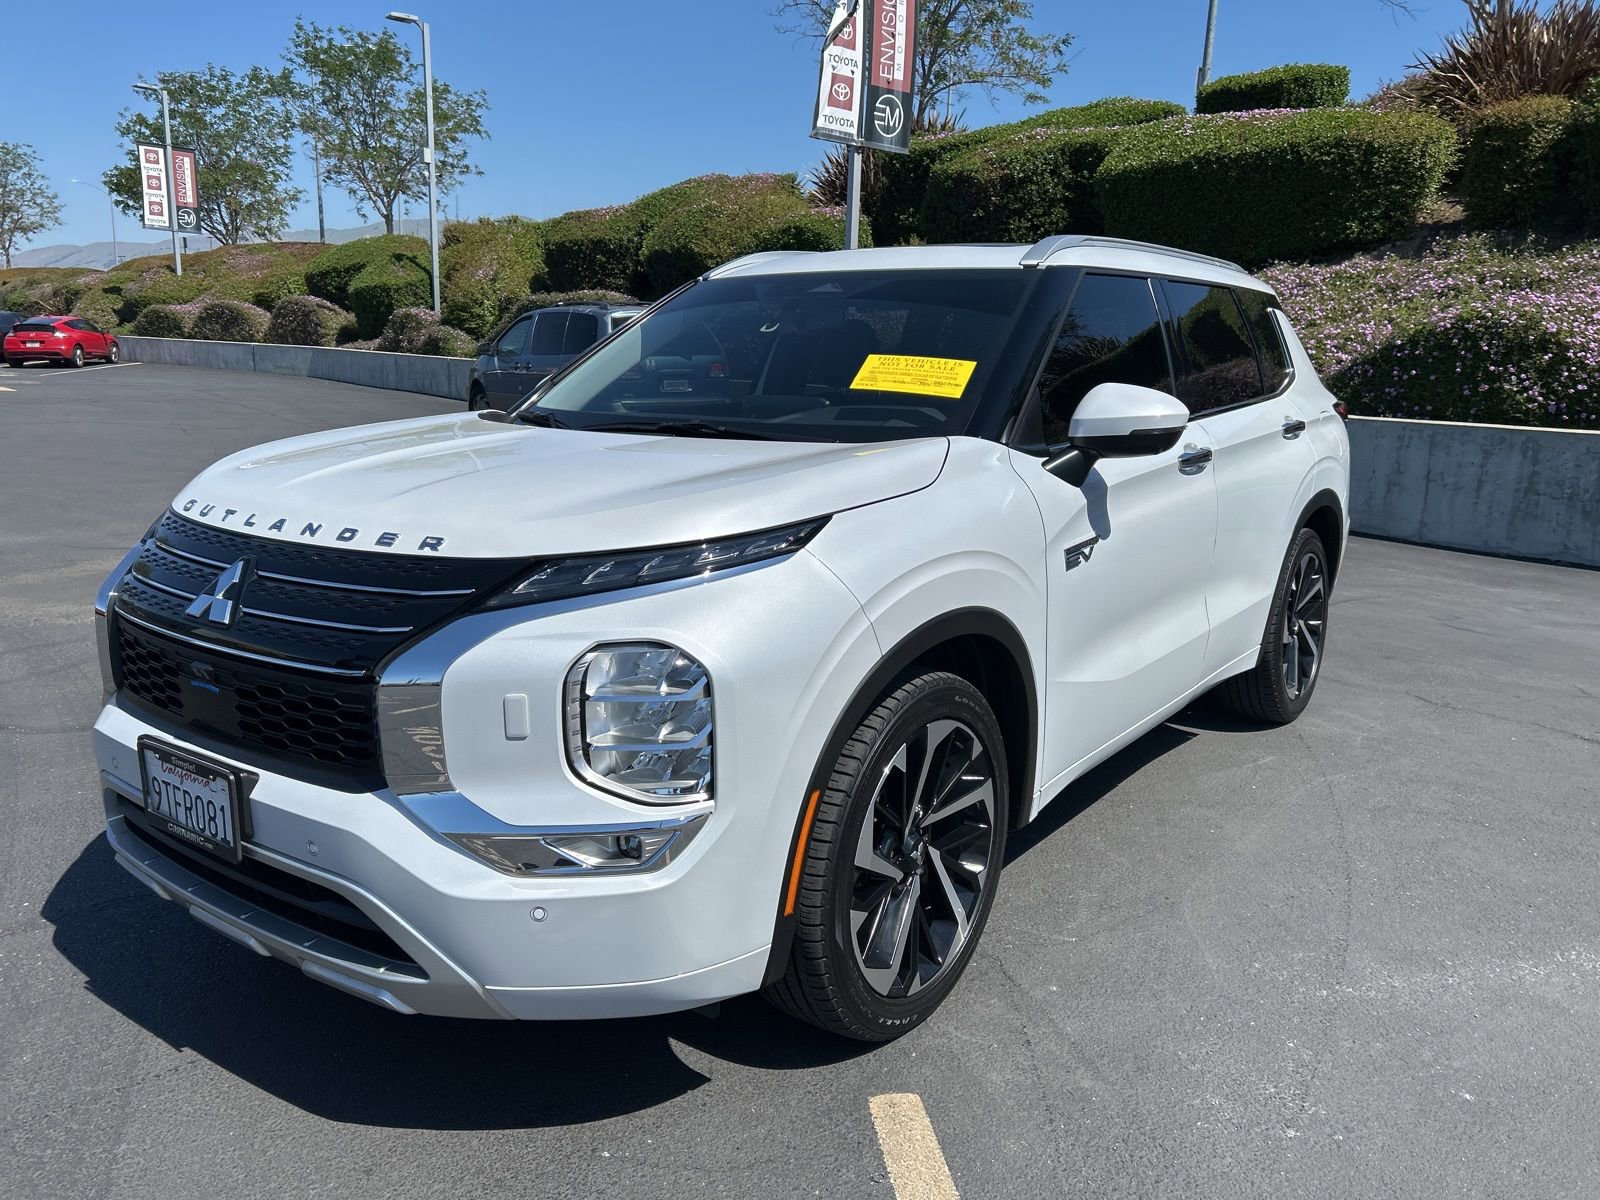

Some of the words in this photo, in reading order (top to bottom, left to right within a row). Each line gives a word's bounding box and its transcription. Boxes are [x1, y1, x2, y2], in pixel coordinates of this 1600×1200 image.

[828, 53, 859, 69] TOYOTA
[822, 114, 855, 129] TOYOTA
[175, 155, 187, 204] ENVISION
[904, 358, 949, 366] VEHICLE
[183, 499, 446, 551] OUTLANDER
[152, 775, 232, 847] 9TFR081
